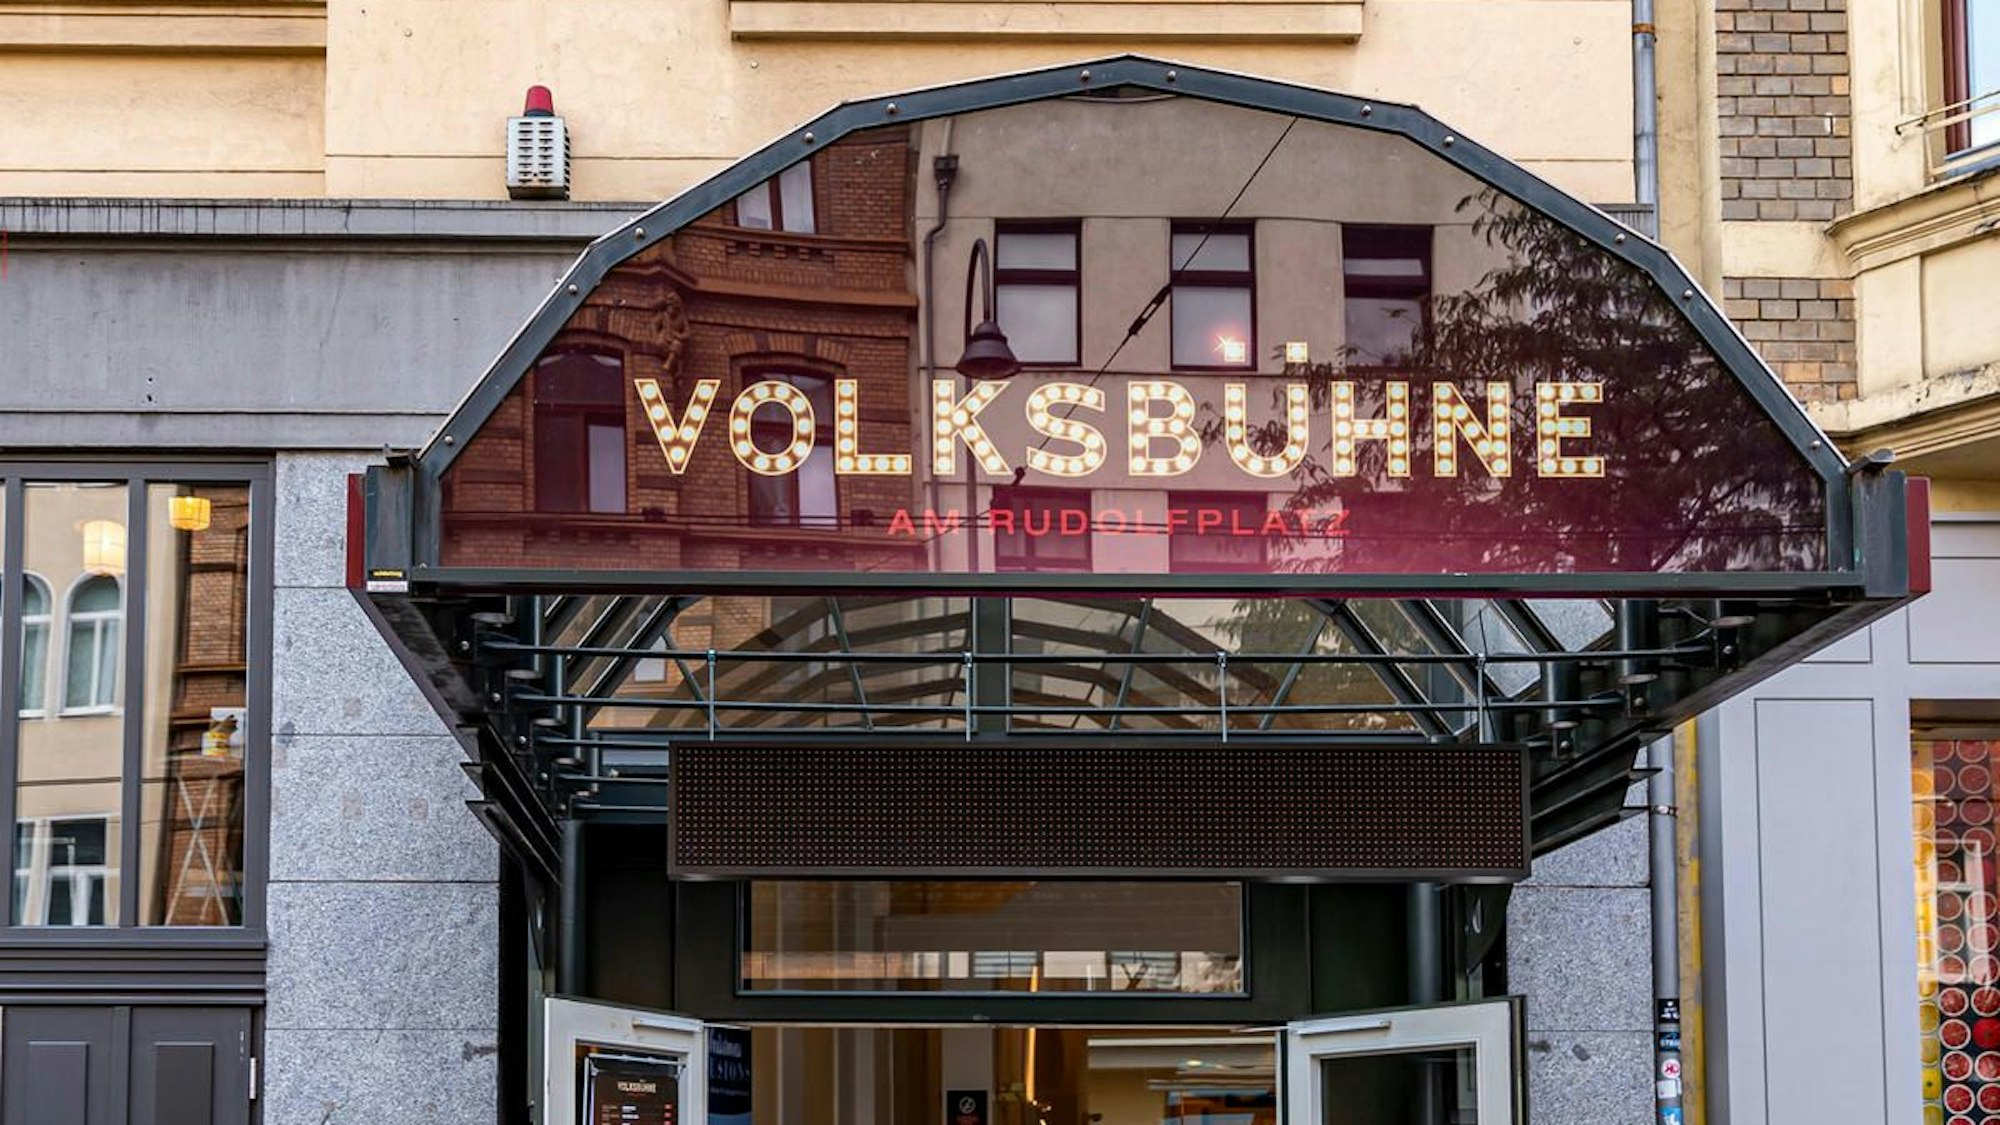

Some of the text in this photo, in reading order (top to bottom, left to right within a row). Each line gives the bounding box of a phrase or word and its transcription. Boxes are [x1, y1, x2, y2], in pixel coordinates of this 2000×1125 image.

[634, 342, 1606, 478] VOLKSBÜHNE
[887, 508, 1353, 537] AM RUDOLFPLATZ
